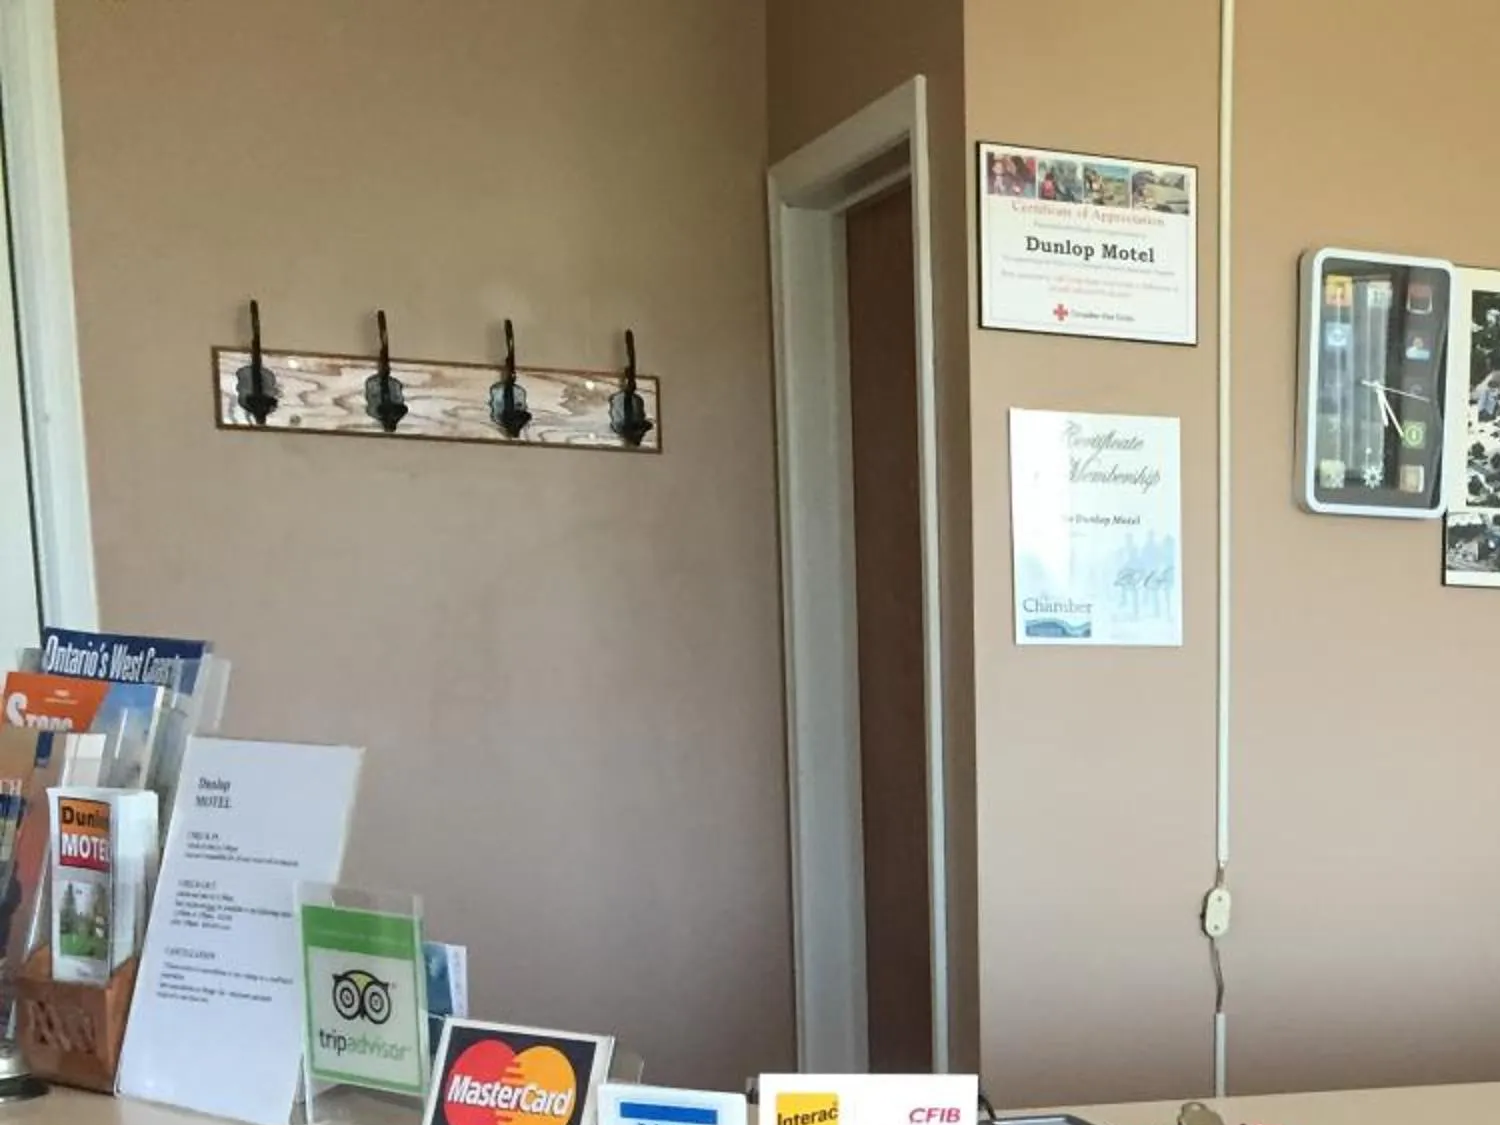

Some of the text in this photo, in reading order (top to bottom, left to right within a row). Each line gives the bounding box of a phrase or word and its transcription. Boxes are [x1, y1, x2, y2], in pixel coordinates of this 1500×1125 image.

[1026, 235, 1155, 263] Dunlop Motel
[45, 635, 109, 678] Ontario's
[109, 642, 142, 682] West
[319, 1028, 407, 1061] tripadvisor
[447, 1074, 573, 1117] MasterCard
[908, 1106, 961, 1124] CFIB
